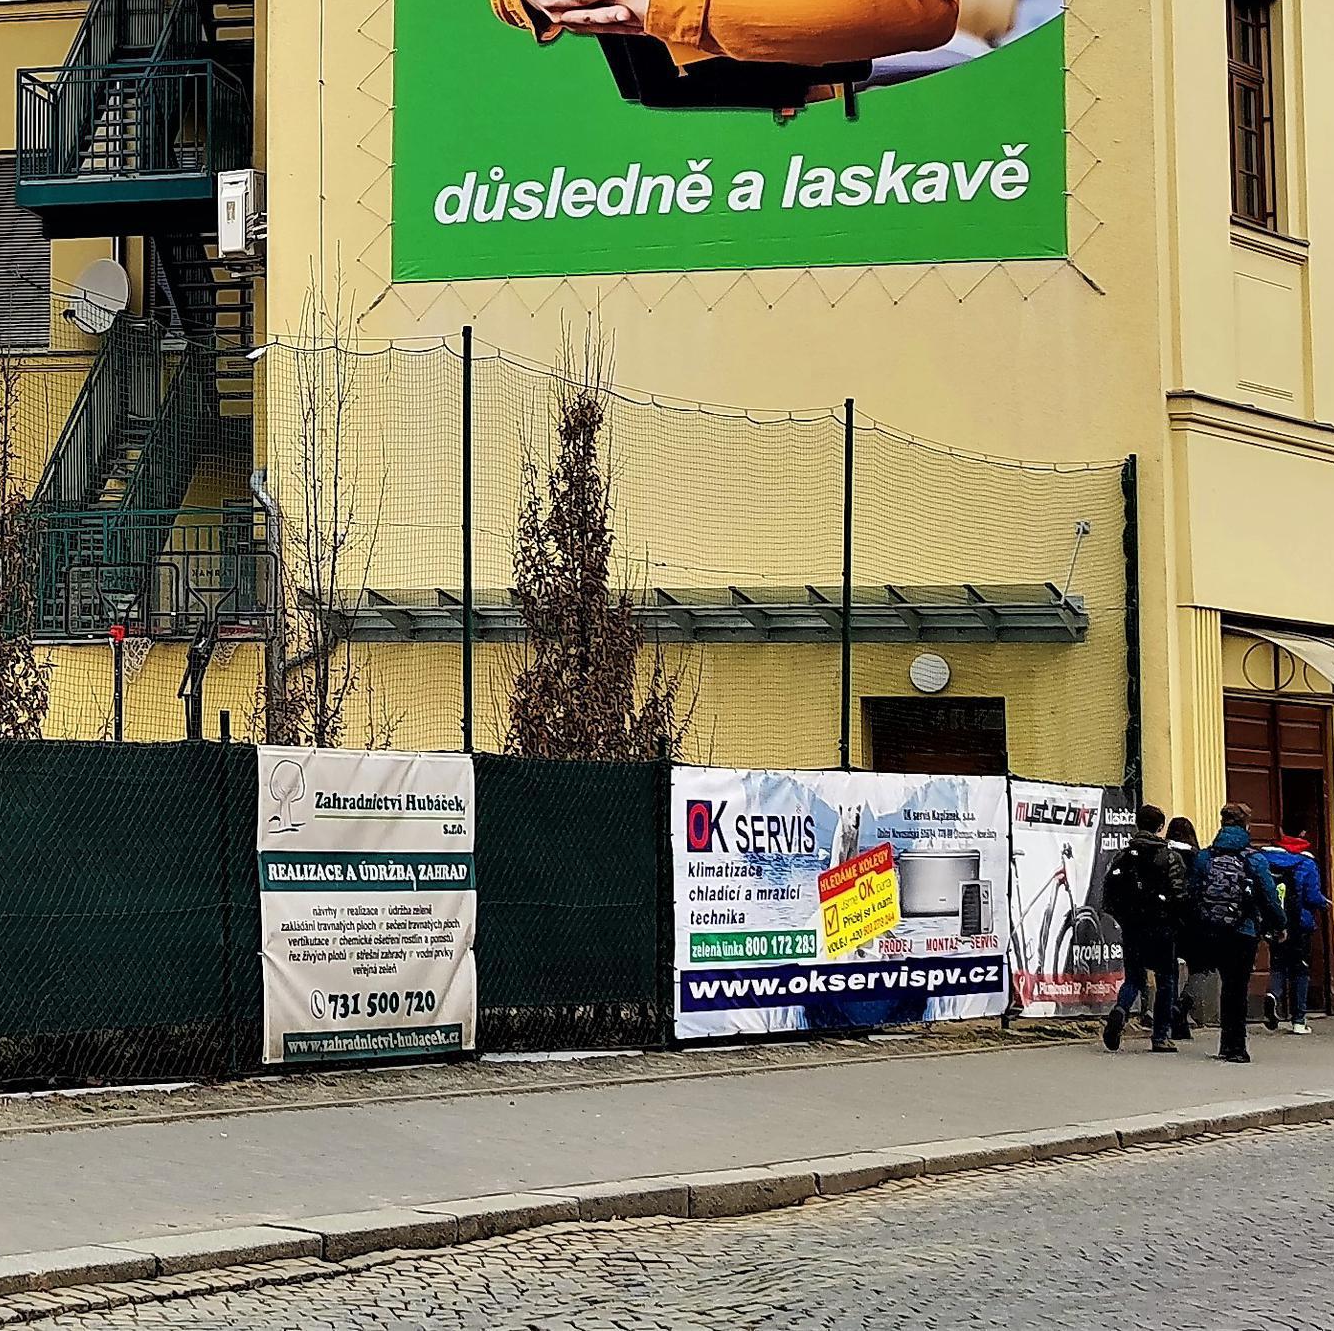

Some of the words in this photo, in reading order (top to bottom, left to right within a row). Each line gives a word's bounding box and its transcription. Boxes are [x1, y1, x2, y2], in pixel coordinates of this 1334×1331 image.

[433, 157, 713, 225] důsledně
[727, 168, 765, 212] a
[780, 142, 1030, 210] laskavě
[314, 791, 402, 811] Zahradnictví
[687, 800, 730, 853] OK
[734, 814, 816, 854] SERVIS
[267, 863, 343, 882] REALIZACE
[346, 864, 358, 881] A
[360, 859, 415, 882] ÚDRŽBA
[418, 864, 468, 881] ZAHRAD
[687, 861, 764, 878] klimatizace
[745, 889, 752, 901] a
[858, 876, 875, 901] OK
[690, 909, 746, 925] technika
[745, 936, 767, 957] 800
[771, 935, 793, 955] 172
[794, 934, 815, 954] 283
[878, 937, 913, 953] PRODEJ
[970, 934, 999, 950] SERVIS
[688, 965, 999, 1000] www.okservispv.cz
[328, 992, 361, 1020] 731
[367, 991, 400, 1017] 500
[405, 990, 436, 1017] 720
